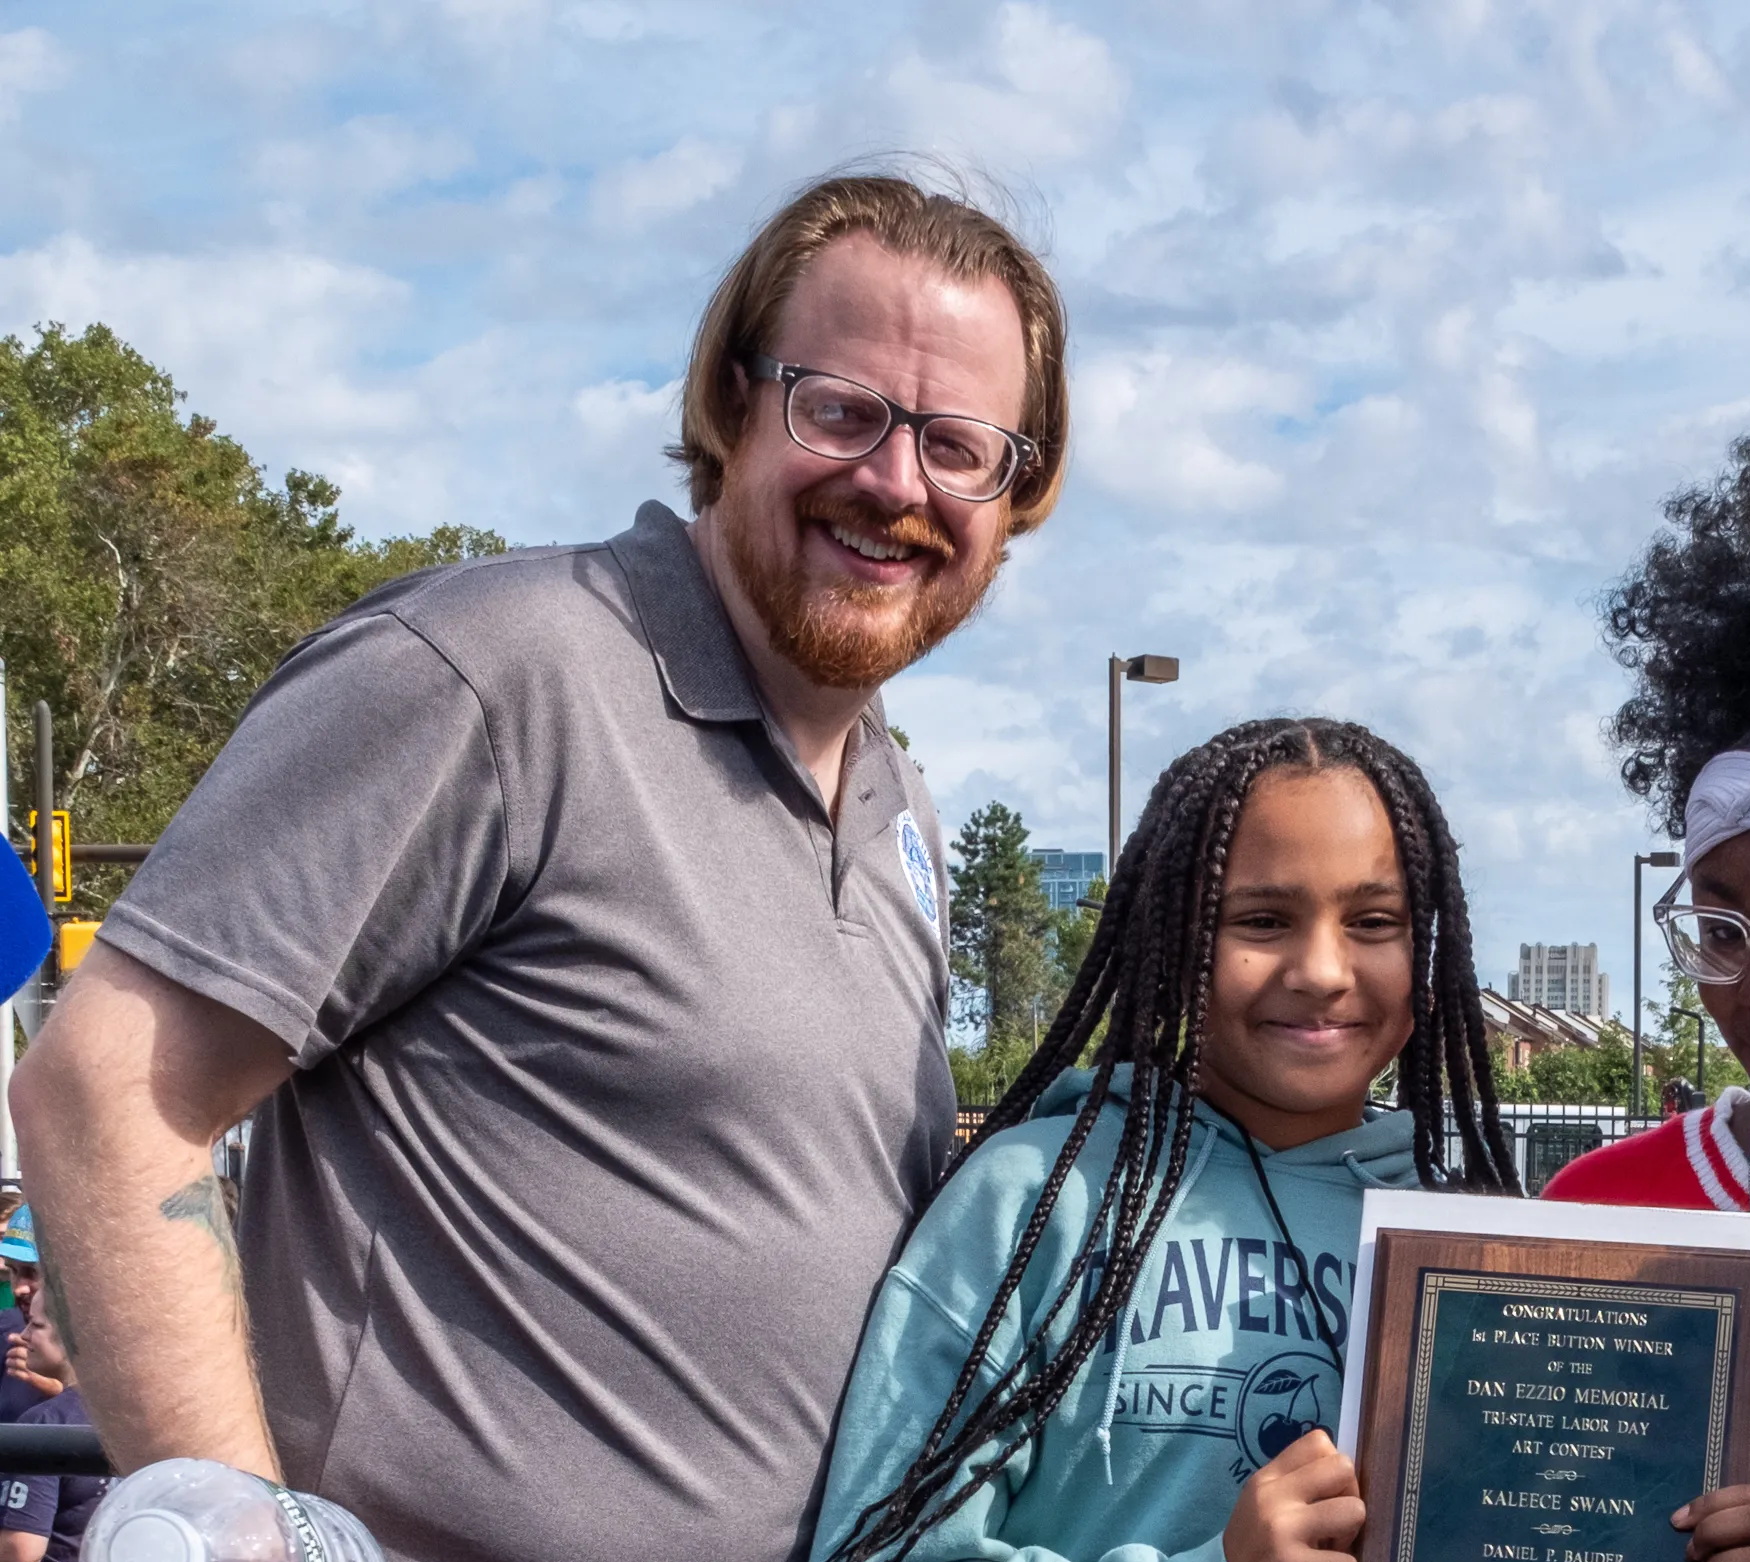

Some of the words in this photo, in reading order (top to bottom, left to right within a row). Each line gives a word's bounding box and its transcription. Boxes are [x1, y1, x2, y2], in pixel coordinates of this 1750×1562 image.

[1503, 1304, 1647, 1326] CONGRATULATIONS
[1472, 1329, 1486, 1342] 1st
[1494, 1330, 1539, 1346] PLACE
[1548, 1334, 1605, 1350] BUTTON
[1614, 1338, 1673, 1356] WINNER
[1548, 1361, 1564, 1373] OF
[1569, 1363, 1593, 1375] THE
[1114, 1383, 1228, 1420] SINCE
[1467, 1380, 1506, 1397] DAN
[1516, 1384, 1566, 1401] EZZIO
[1574, 1389, 1669, 1410] MEMORIAL
[1482, 1410, 1554, 1428] TRI-STATE
[1562, 1416, 1609, 1432] LABOR
[1618, 1421, 1649, 1436] DAY
[1512, 1440, 1543, 1455] ART
[1549, 1442, 1615, 1460] CONTEST
[0, 1480, 28, 1508] 19
[1481, 1489, 1562, 1511] KALEECE
[1569, 1496, 1635, 1516] SWANN
[1483, 1543, 1538, 1561] DANIEL
[1546, 1549, 1557, 1562] P.
